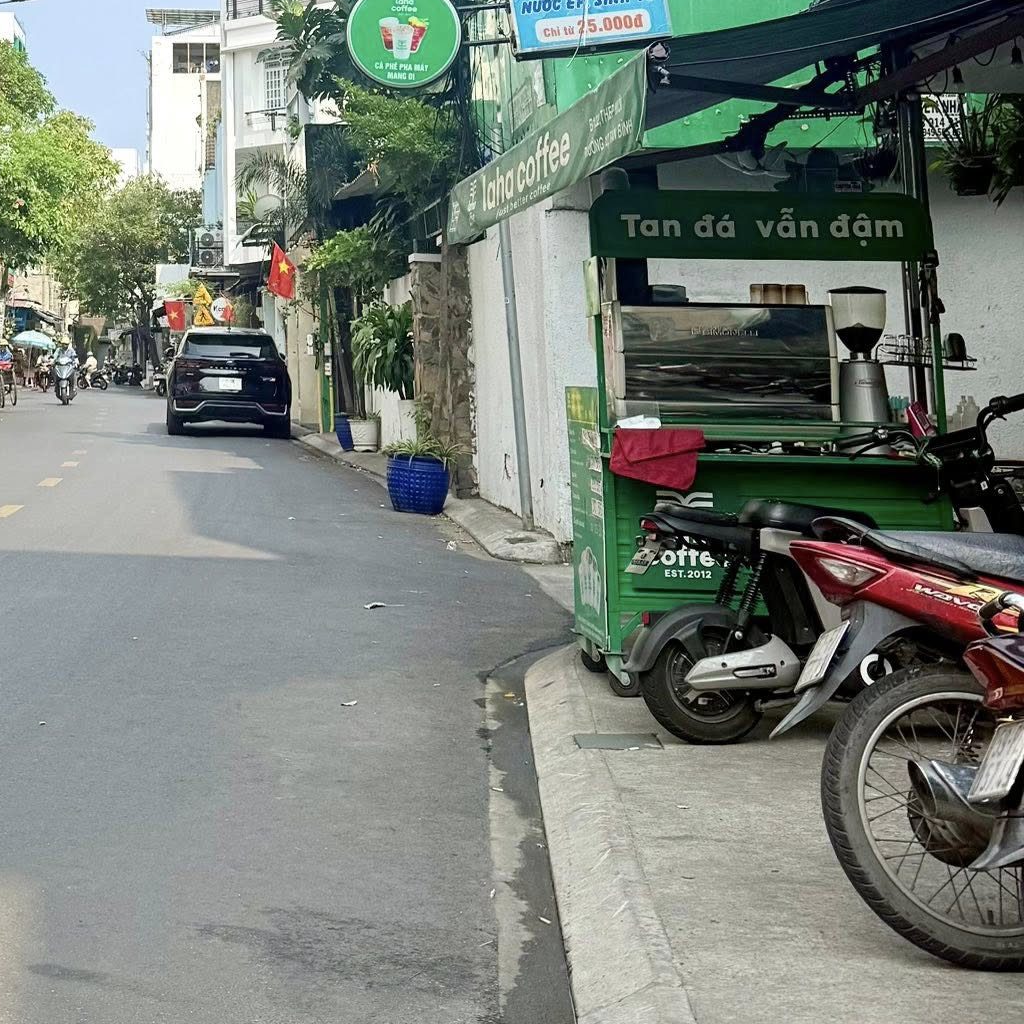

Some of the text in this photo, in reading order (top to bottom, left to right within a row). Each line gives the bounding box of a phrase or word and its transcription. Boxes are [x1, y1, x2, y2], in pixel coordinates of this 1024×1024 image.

[391, 5, 417, 13] coffee
[399, 63, 413, 72] PHA
[387, 72, 407, 80] MANG
[480, 167, 514, 212] laha
[516, 131, 571, 193] coffee
[495, 204, 509, 220] just
[510, 194, 529, 211] better
[529, 182, 551, 200] coffee
[620, 207, 904, 247] Tan đá vẫn đậm
[664, 569, 712, 579] EST.2012
